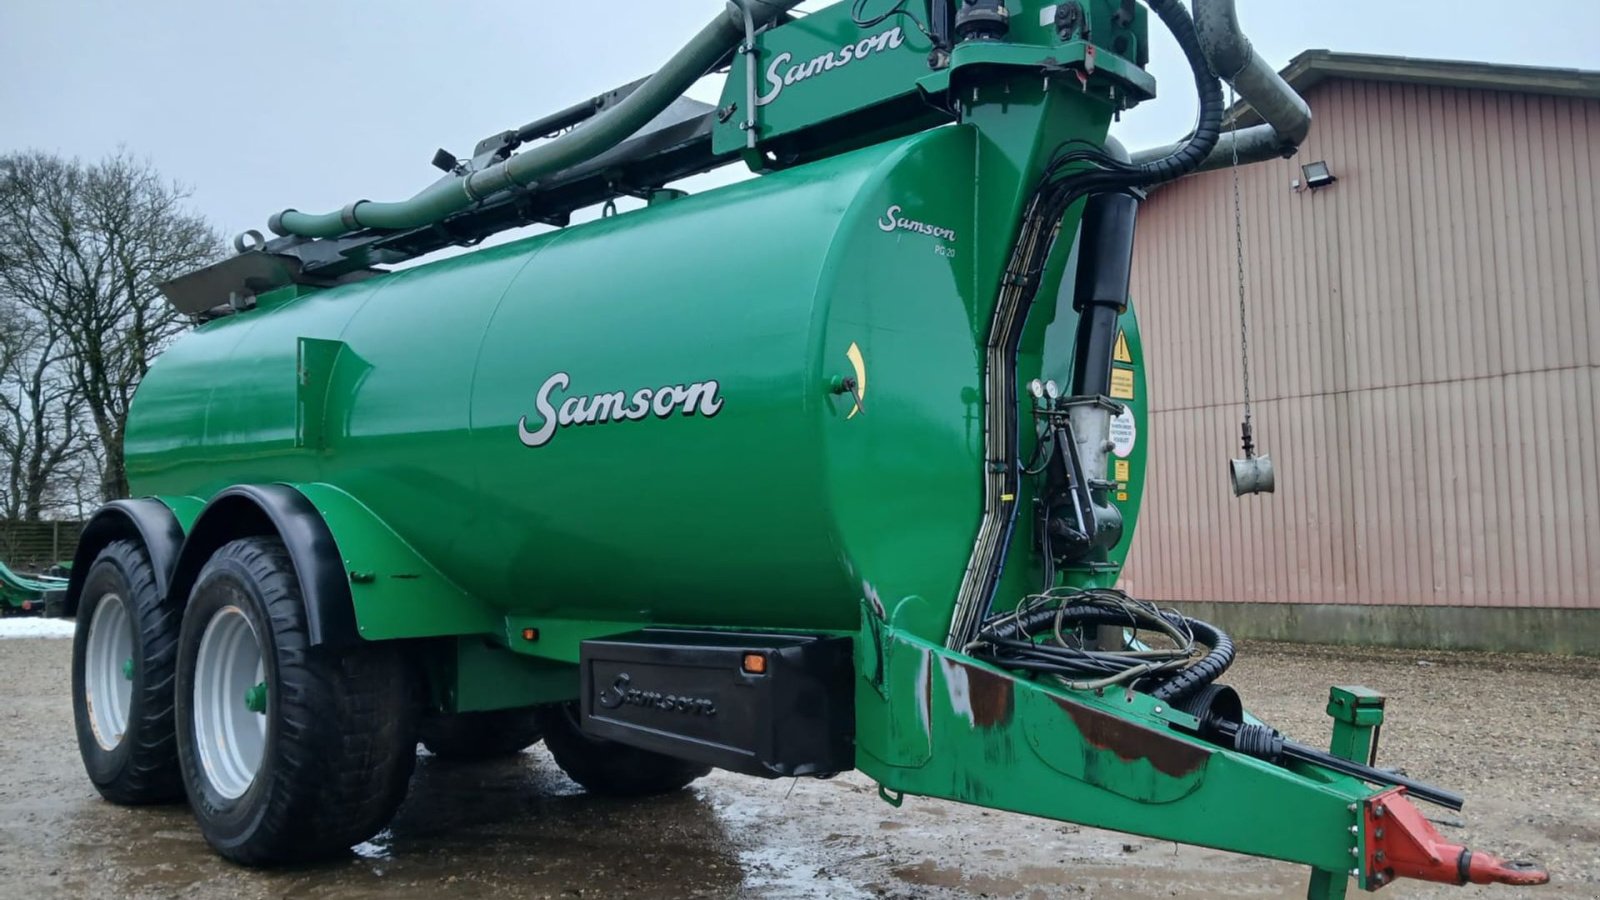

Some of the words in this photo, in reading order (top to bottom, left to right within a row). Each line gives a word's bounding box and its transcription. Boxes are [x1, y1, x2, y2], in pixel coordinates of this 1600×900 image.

[755, 26, 905, 106] Samson
[878, 205, 956, 242] Samson
[934, 244, 946, 257] PG
[946, 247, 956, 259] 20
[518, 371, 723, 447] Samson
[600, 672, 717, 716] Samson
